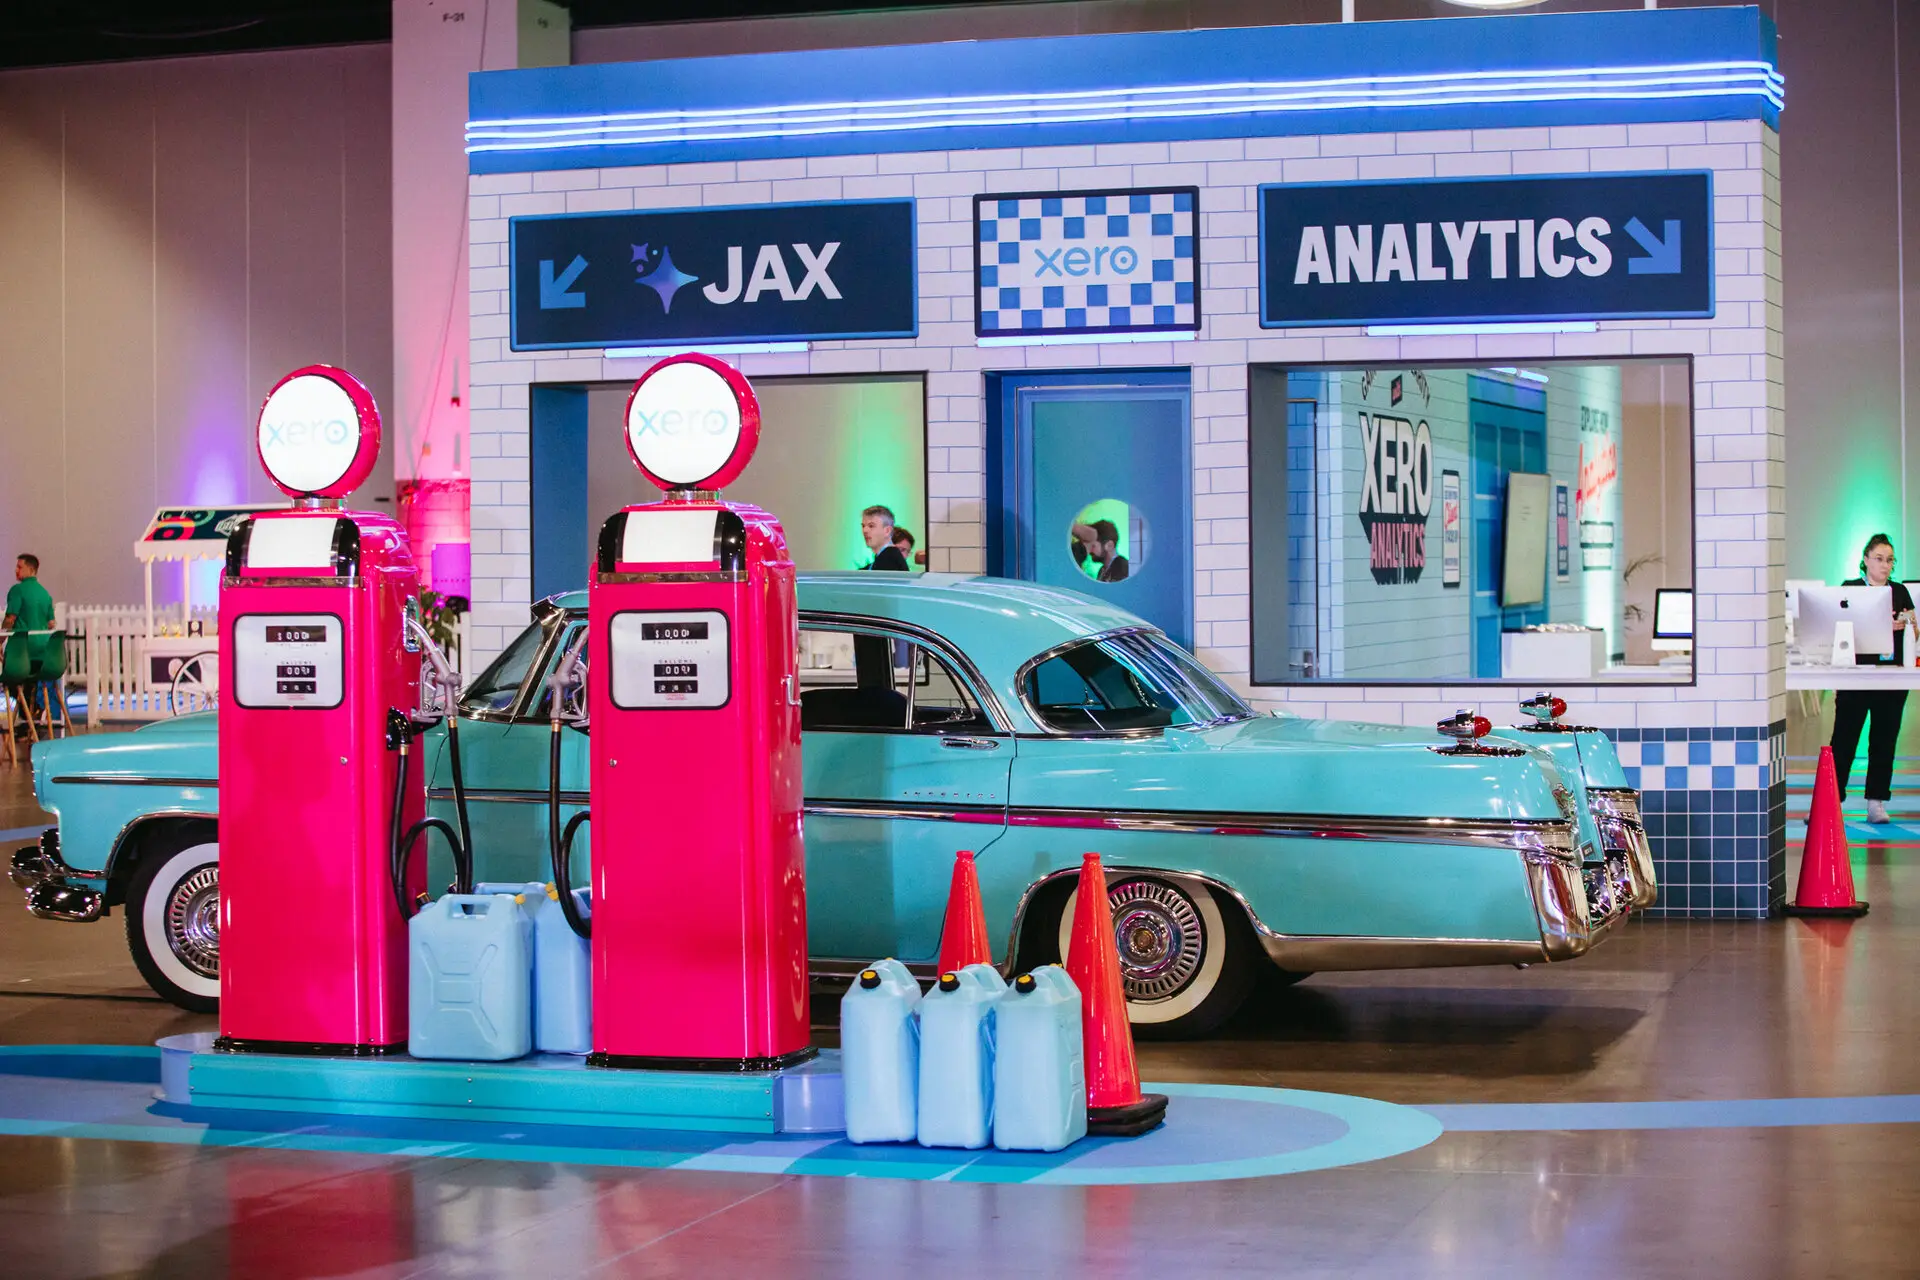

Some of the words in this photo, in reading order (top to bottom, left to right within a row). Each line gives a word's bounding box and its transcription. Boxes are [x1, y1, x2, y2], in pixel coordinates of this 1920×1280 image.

[702, 242, 843, 305] JAX
[1034, 245, 1138, 278] xero
[1294, 216, 1612, 284] ANALYTICS
[266, 419, 348, 448] xero
[637, 409, 728, 437] xero
[1359, 413, 1432, 517] XERO
[1370, 522, 1426, 569] ANALYTICS
